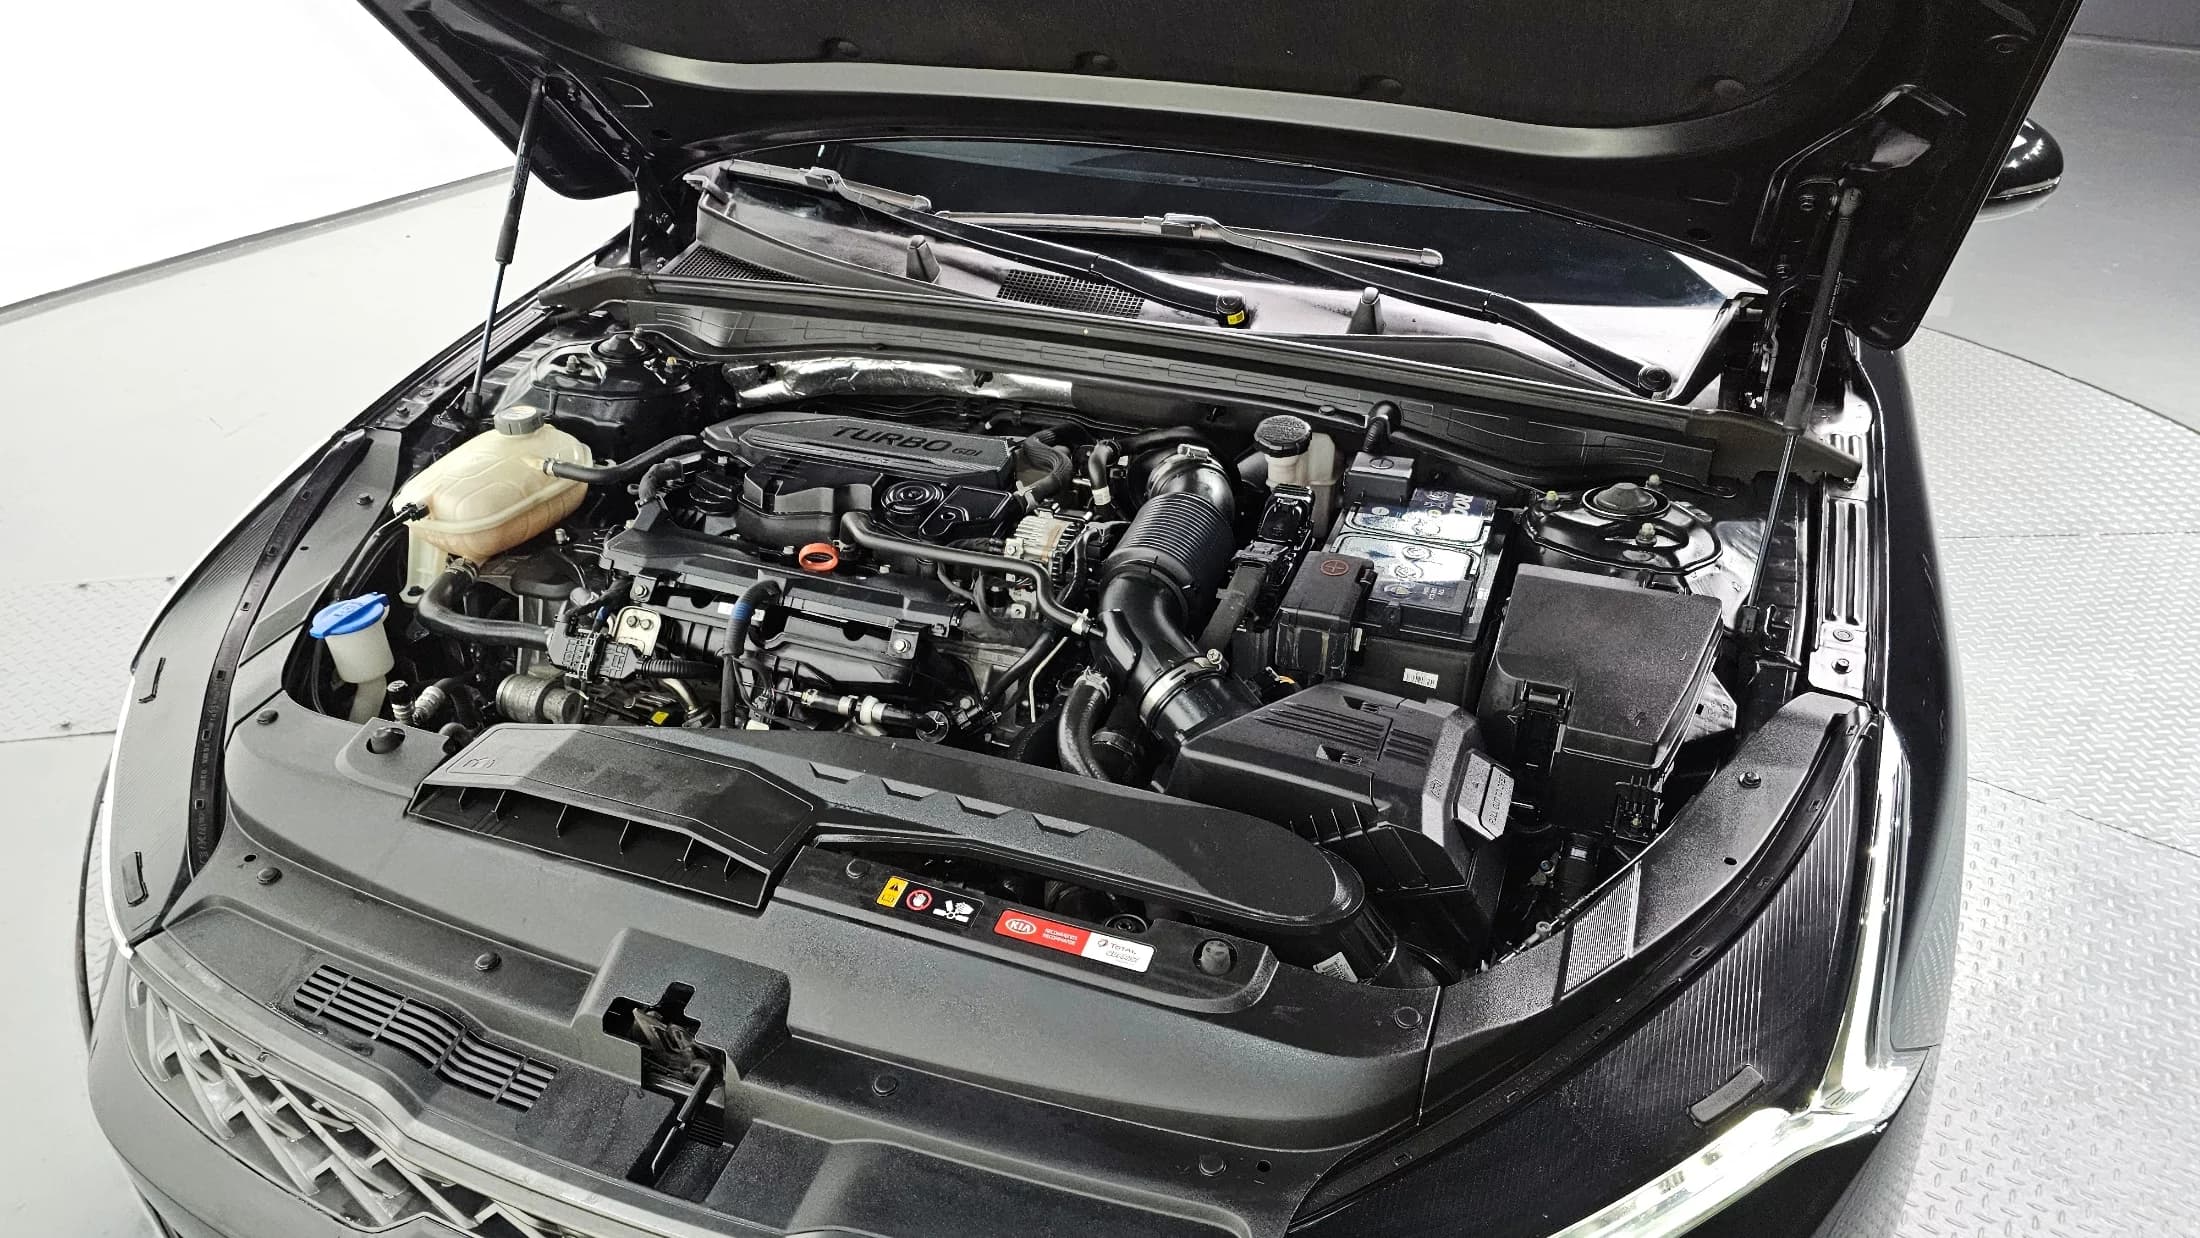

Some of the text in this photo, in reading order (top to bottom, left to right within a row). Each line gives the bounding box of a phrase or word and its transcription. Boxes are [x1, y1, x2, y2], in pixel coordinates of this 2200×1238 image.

[832, 426, 983, 457] TURBO GDI
[1009, 919, 1032, 933] KIA
[1110, 942, 1137, 955] TOTAL
